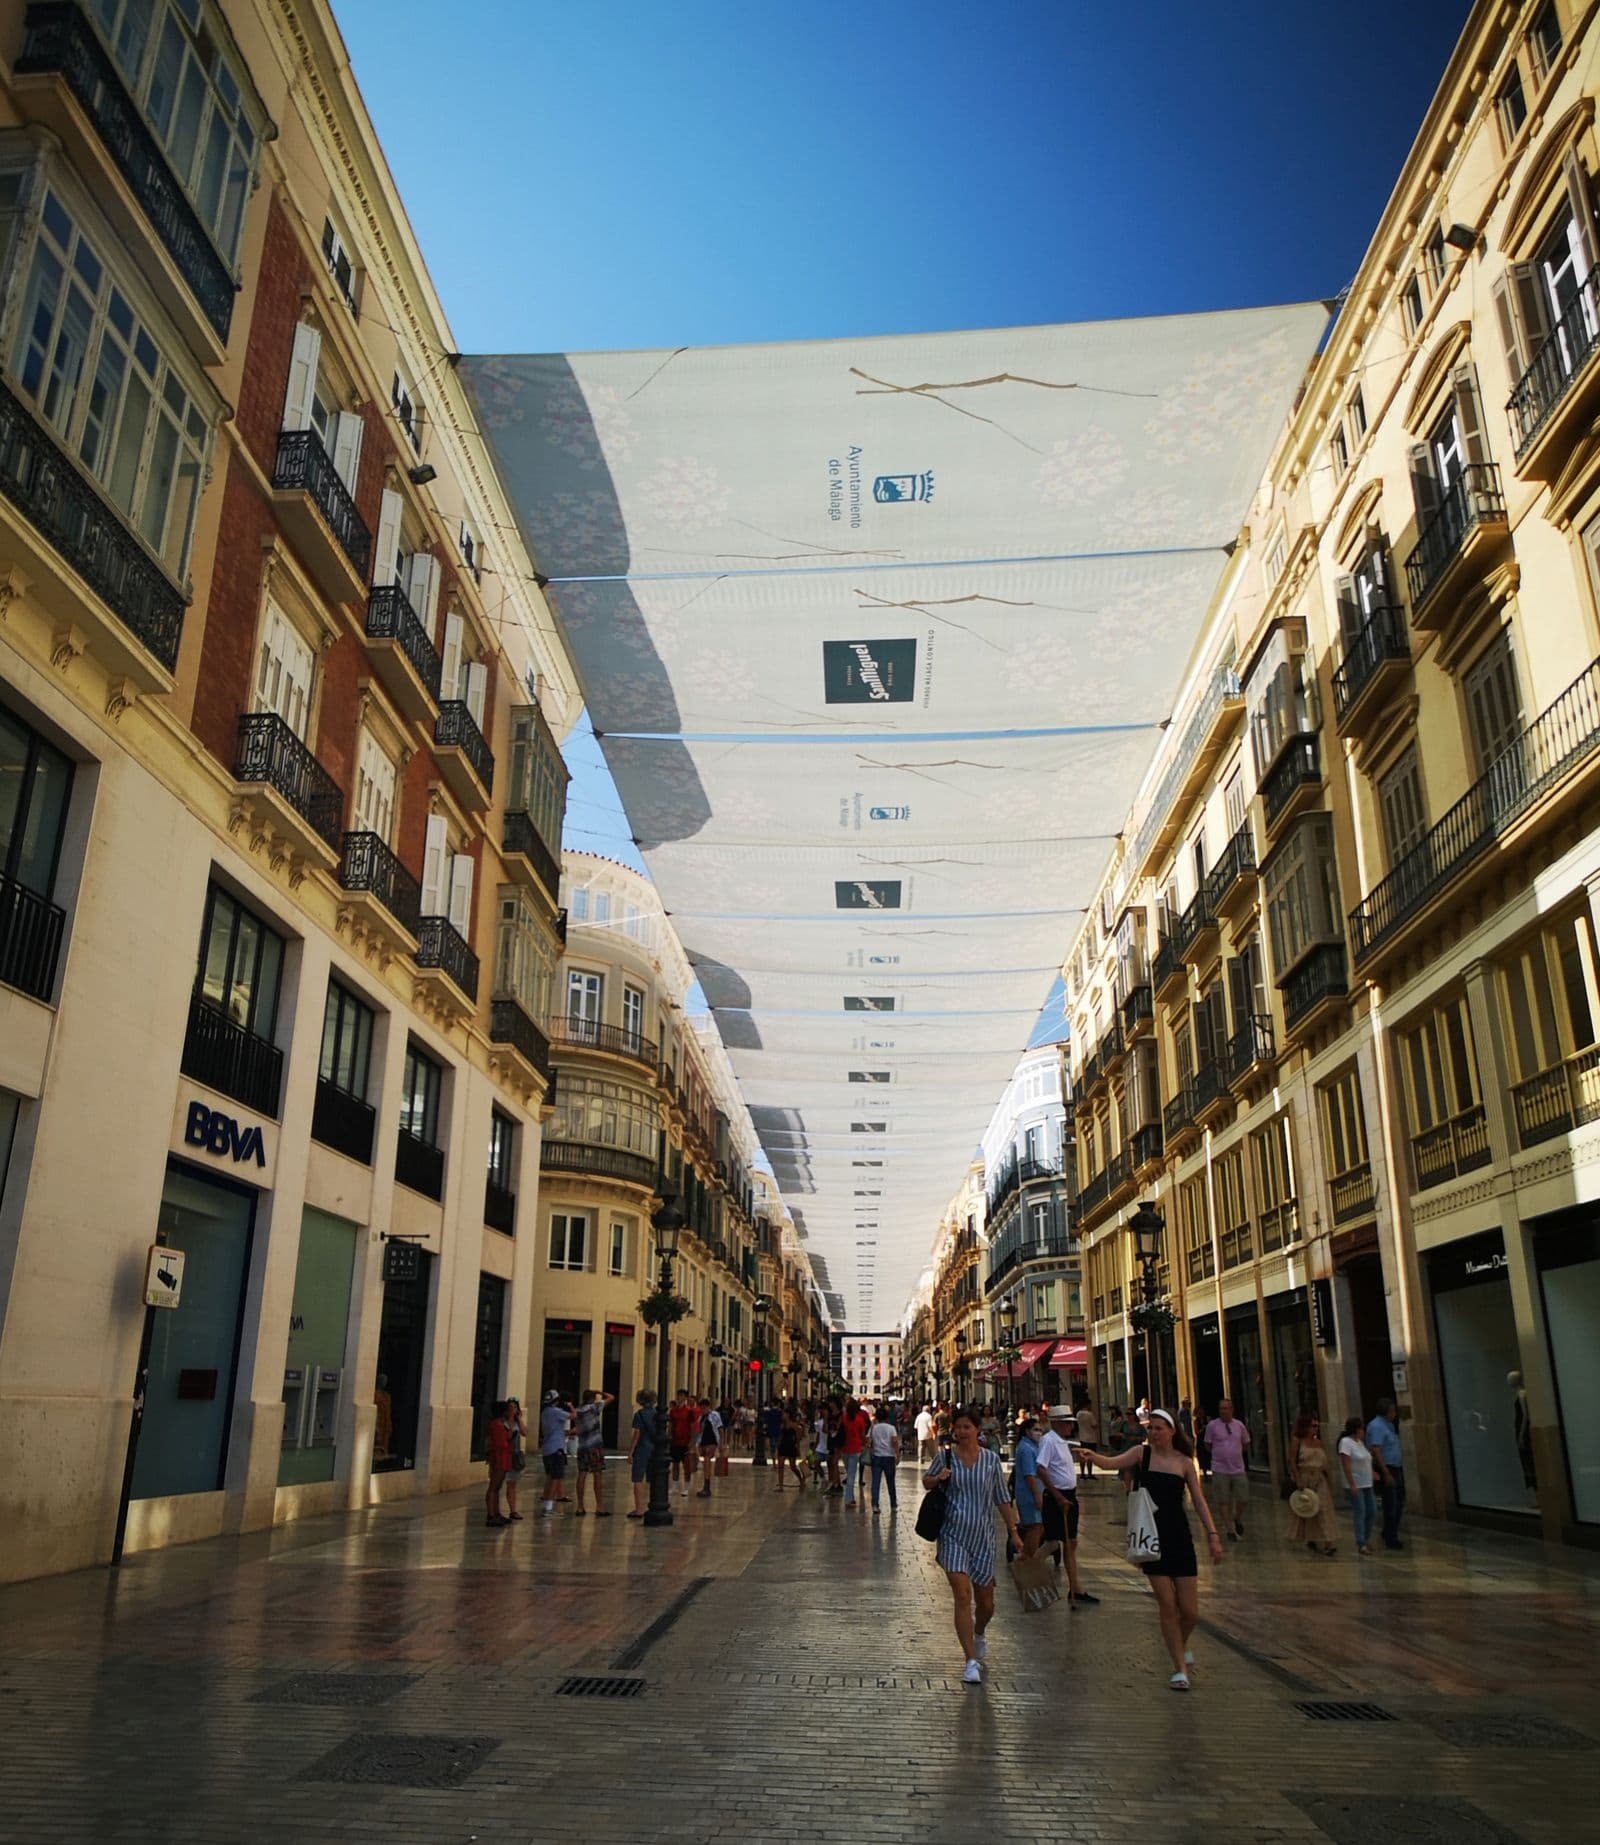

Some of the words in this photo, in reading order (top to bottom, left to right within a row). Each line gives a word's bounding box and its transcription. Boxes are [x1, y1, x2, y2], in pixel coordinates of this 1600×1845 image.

[828, 459, 842, 475] de
[846, 445, 863, 529] Ayuntamiento
[828, 480, 843, 521] Málaga
[925, 629, 935, 661] CONTIGO
[184, 1101, 265, 1168] BBVA
